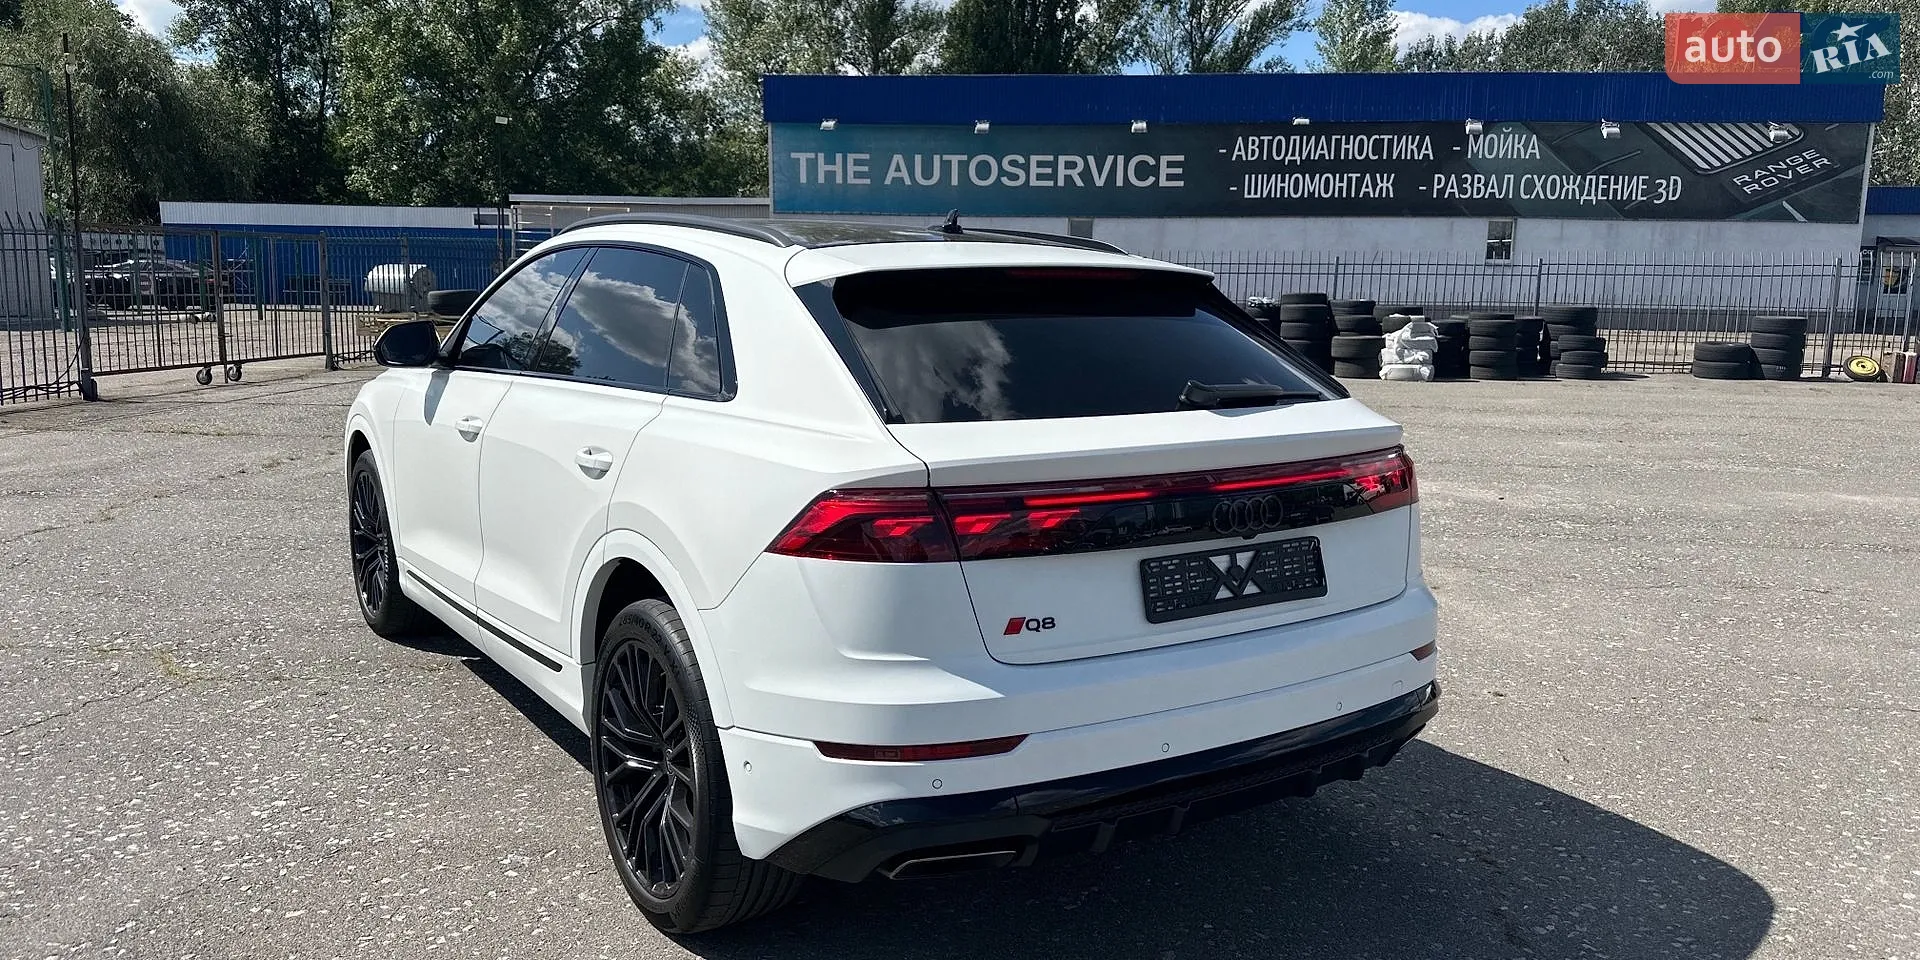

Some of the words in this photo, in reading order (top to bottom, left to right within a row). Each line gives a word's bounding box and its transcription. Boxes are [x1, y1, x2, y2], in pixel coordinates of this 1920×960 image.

[1231, 134, 1434, 165] АВТОДИАГНОСТИКА
[1466, 127, 1541, 160] МОЙКА
[790, 151, 871, 185] THE
[884, 153, 1185, 188] AUTOSERVICE
[1733, 148, 1820, 185] RANGE
[1742, 156, 1832, 195] ROVER
[1243, 173, 1395, 199] ШИНОМОНТАЖ
[1432, 174, 1514, 199] РАЗВАЛ
[1519, 174, 1649, 205] СХОЖДЕНИЕ
[1653, 175, 1682, 204] 3D
[1025, 616, 1056, 633] Q8
